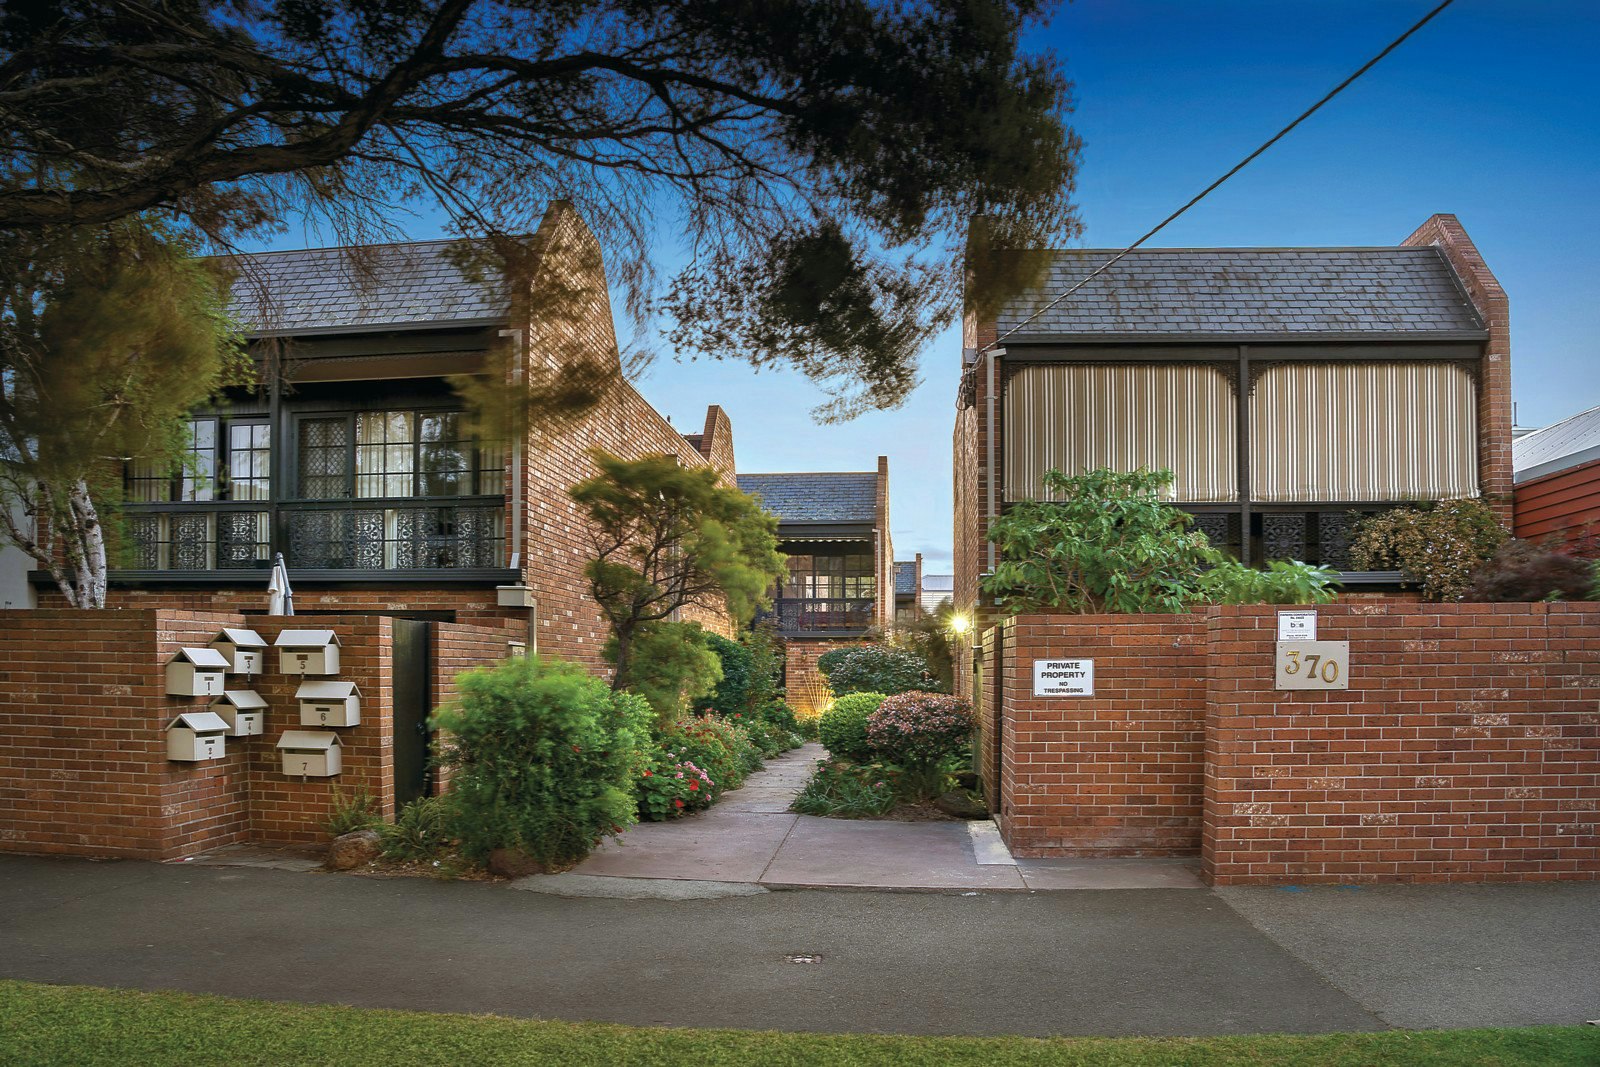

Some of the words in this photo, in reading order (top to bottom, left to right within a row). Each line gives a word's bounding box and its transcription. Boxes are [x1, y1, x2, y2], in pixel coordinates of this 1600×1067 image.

[300, 661, 306, 670] 5
[1285, 651, 1339, 683] 370
[320, 712, 326, 721] 6
[302, 762, 308, 771] 7
